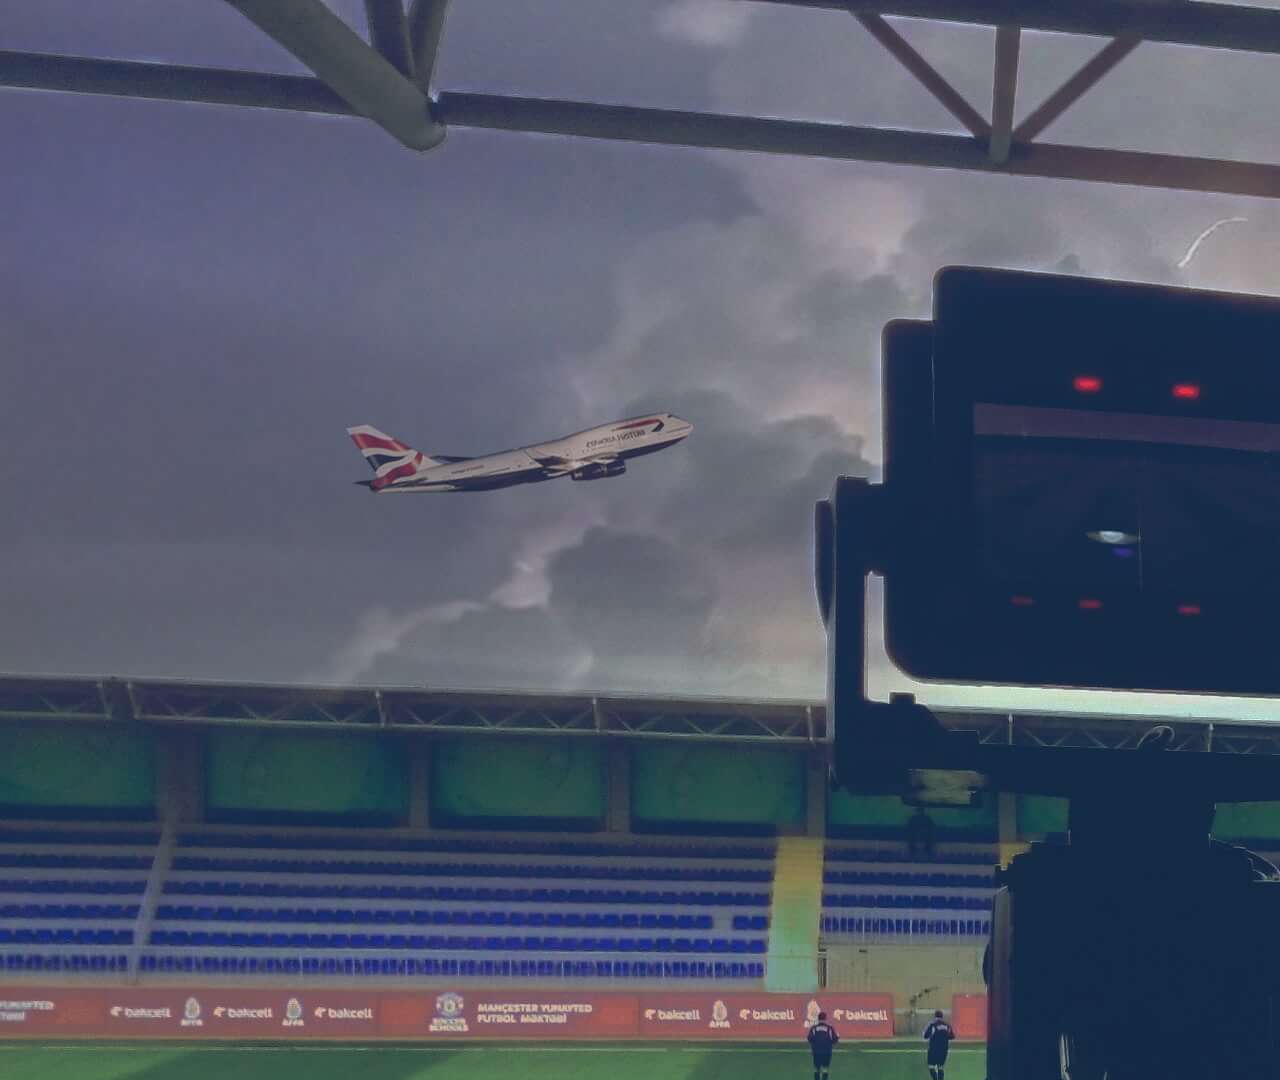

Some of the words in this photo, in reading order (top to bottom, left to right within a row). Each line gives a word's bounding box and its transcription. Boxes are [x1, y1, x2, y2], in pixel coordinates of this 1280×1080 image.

[124, 1007, 171, 1018] bakcell
[227, 1007, 273, 1018] bakcell
[328, 1007, 373, 1018] bakcell
[657, 1009, 700, 1020] bakcell
[752, 1009, 795, 1021] bakcell
[846, 1009, 888, 1021] bakcell
[477, 1014, 517, 1023] FUTBOL
